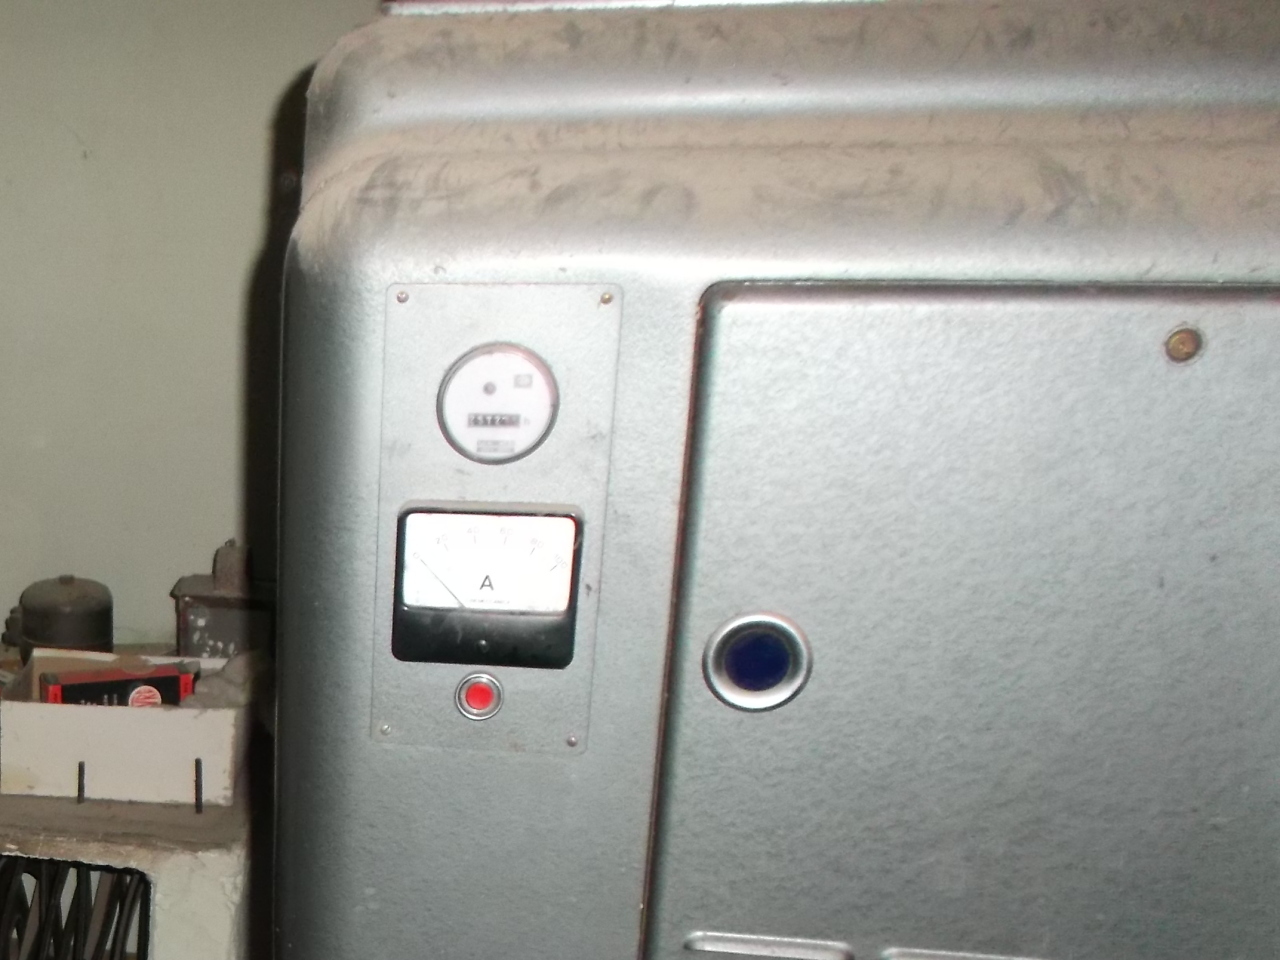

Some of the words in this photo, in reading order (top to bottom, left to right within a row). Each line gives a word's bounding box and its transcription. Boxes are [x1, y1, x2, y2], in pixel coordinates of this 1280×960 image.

[412, 551, 421, 560] 0
[435, 533, 449, 546] 20
[466, 526, 480, 535] 40
[499, 526, 514, 536] 60
[529, 536, 545, 549] 80
[553, 553, 569, 570] 100
[479, 574, 494, 591] A
